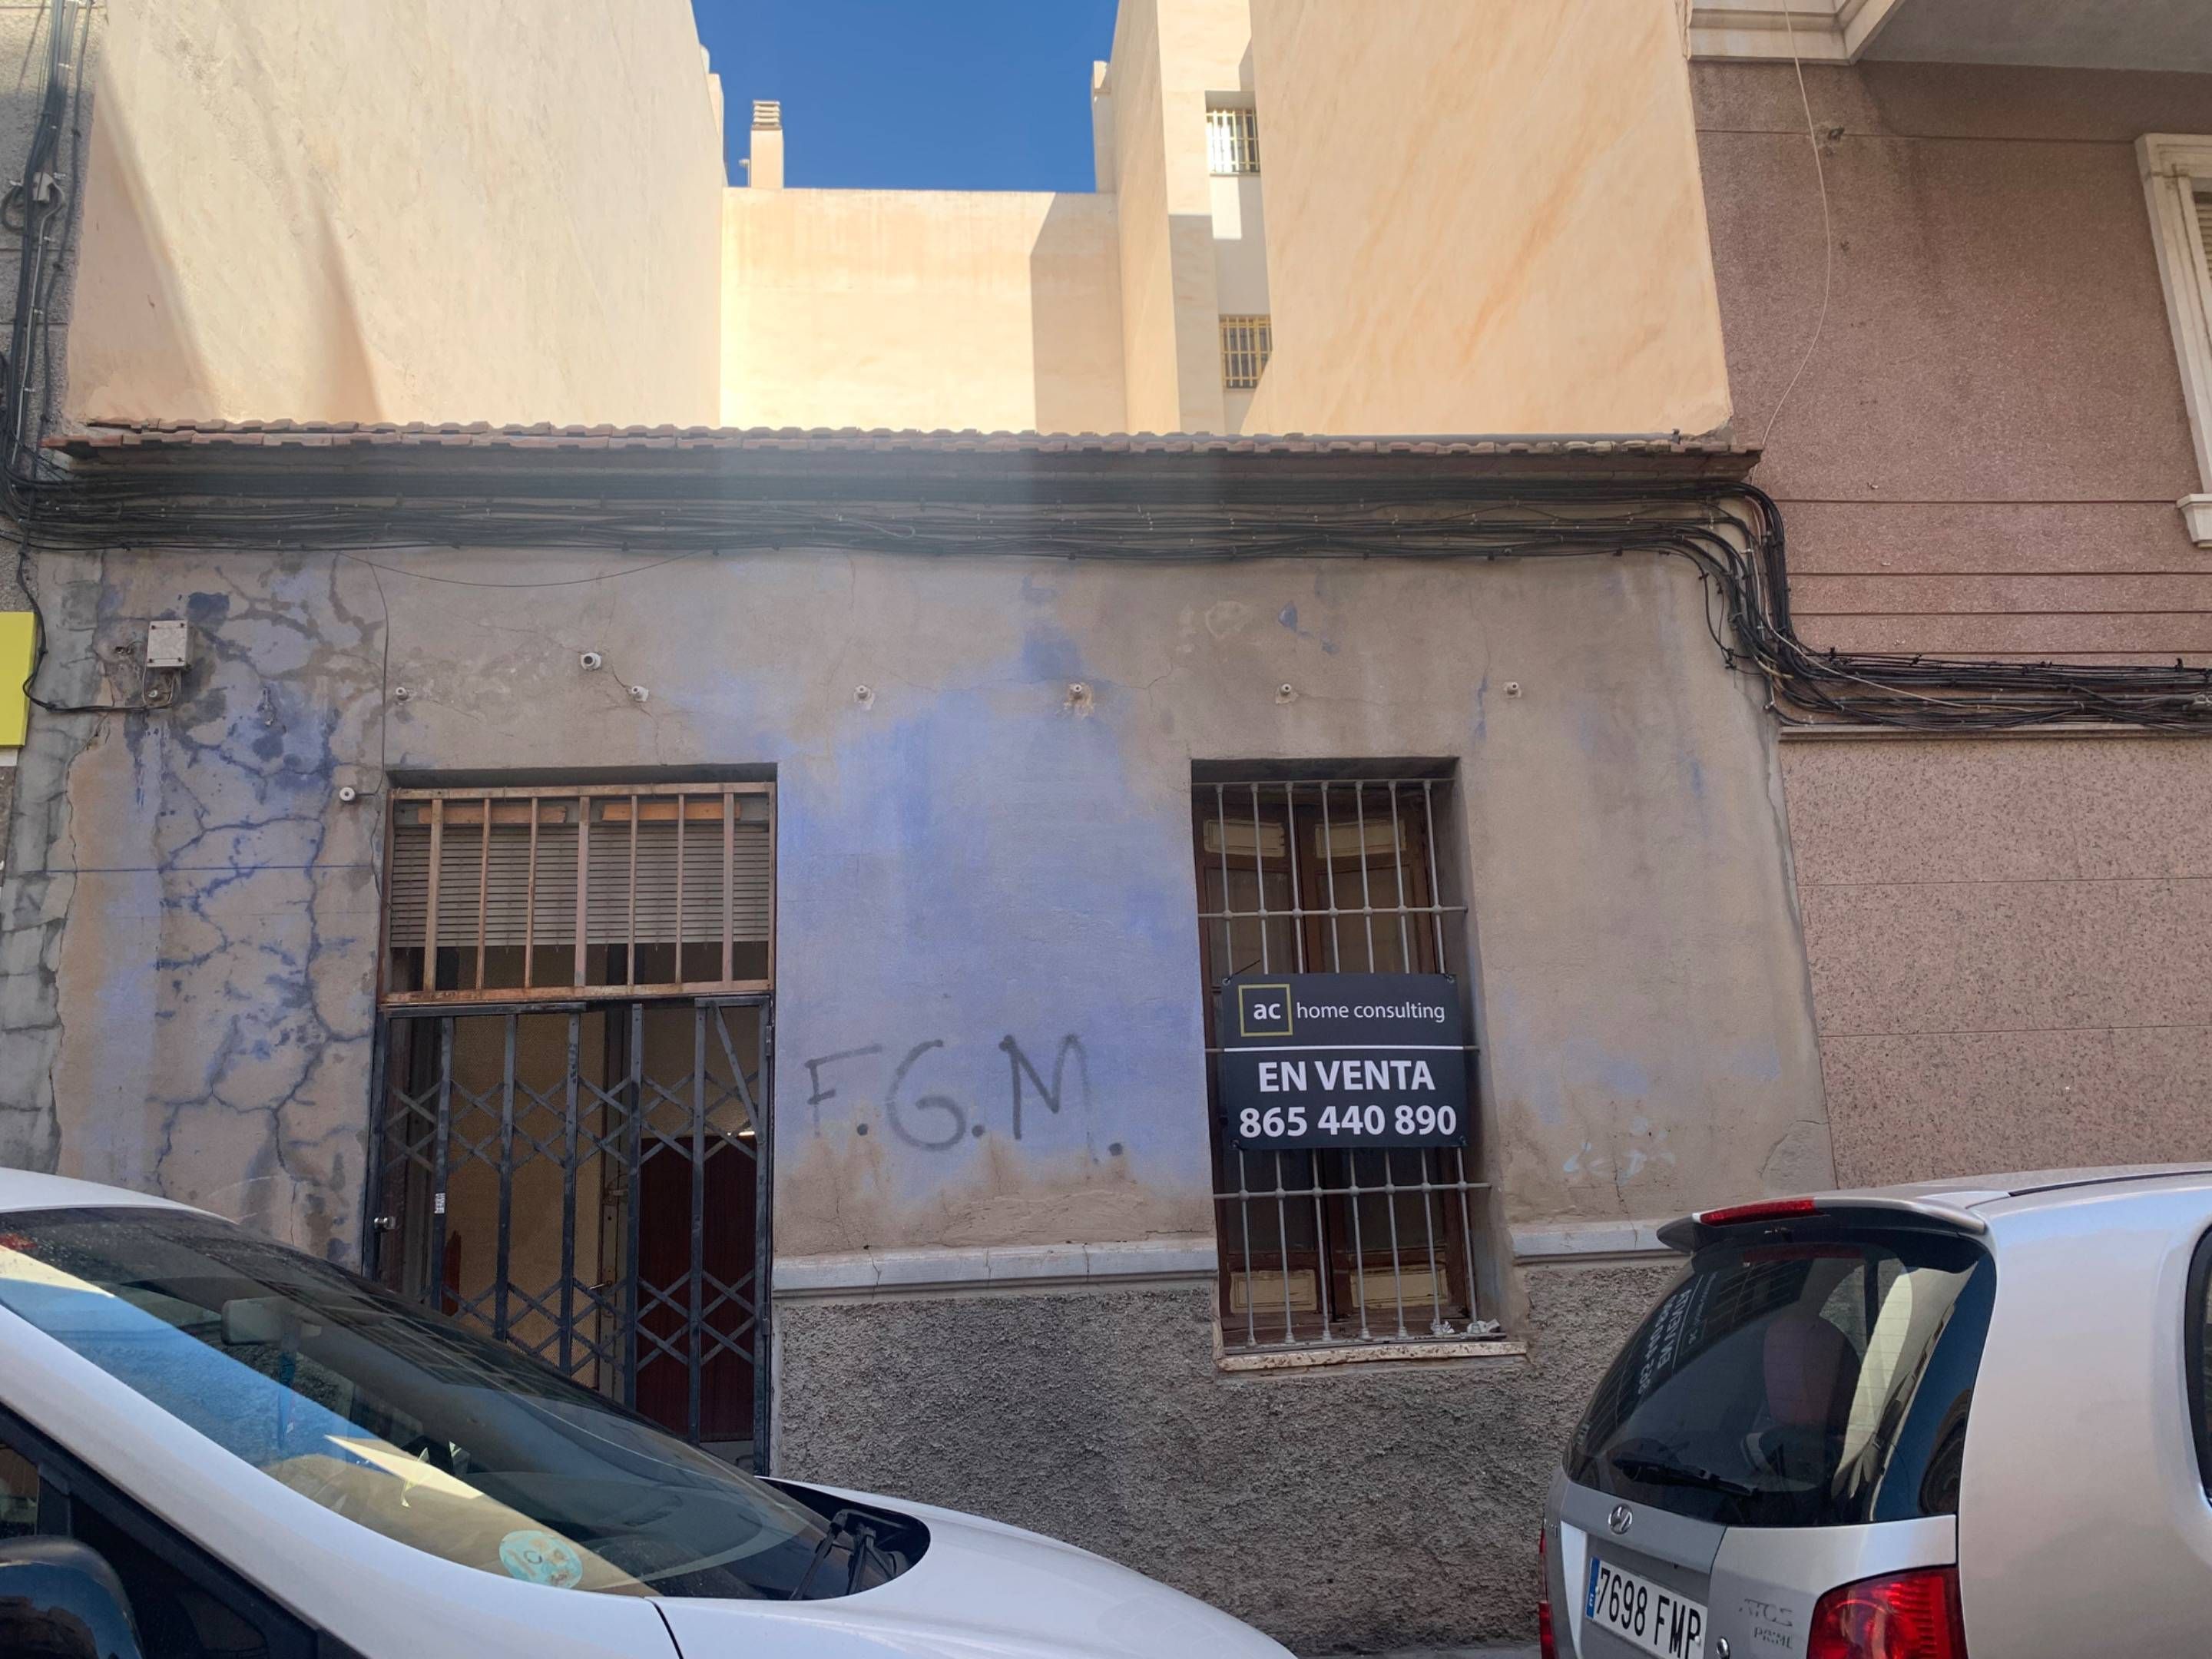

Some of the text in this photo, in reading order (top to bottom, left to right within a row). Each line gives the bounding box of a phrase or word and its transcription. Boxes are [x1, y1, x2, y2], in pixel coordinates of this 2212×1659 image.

[1253, 1002, 1281, 1020] ac
[1296, 1002, 1445, 1023] home consulting
[1258, 1060, 1435, 1092] EN VENTA
[1239, 1104, 1457, 1138] 865 440 890
[1597, 1567, 1701, 1659] 7698 FMP
